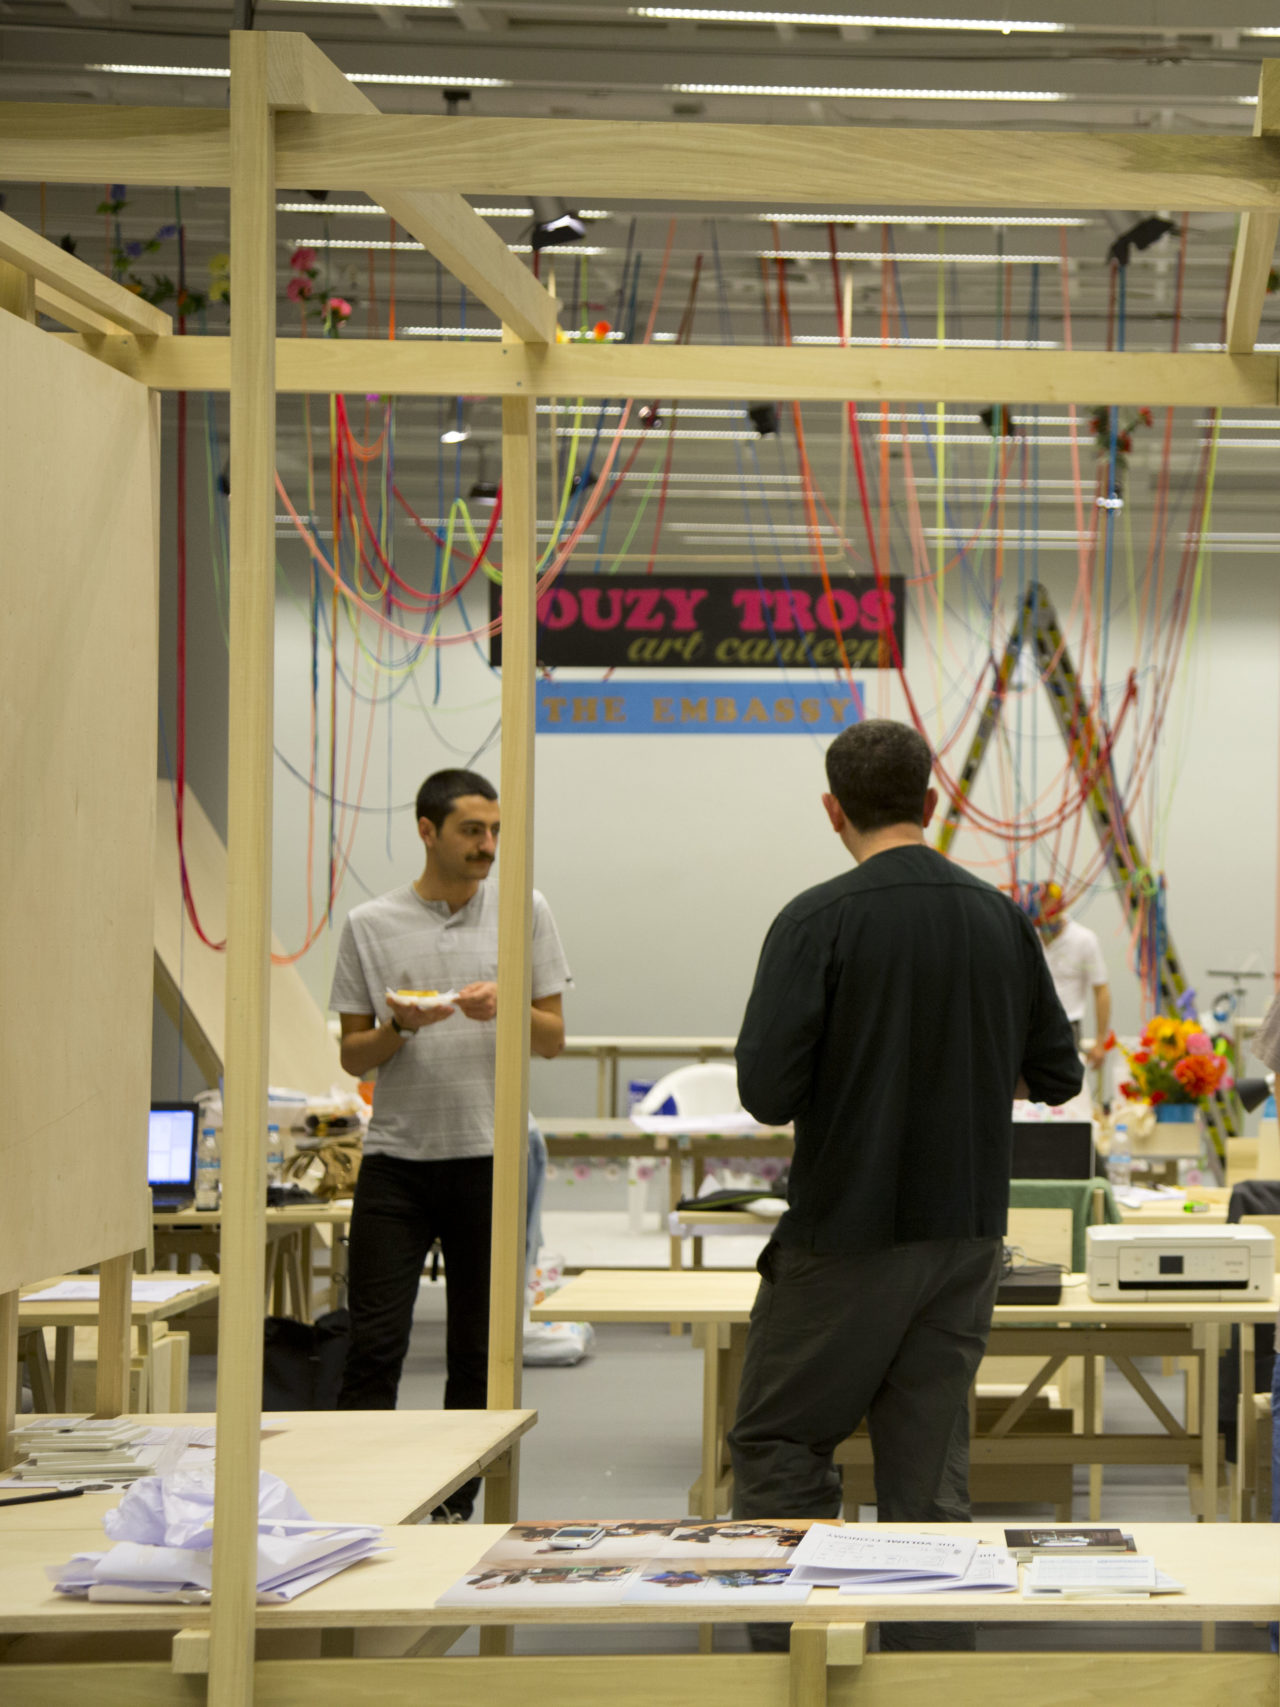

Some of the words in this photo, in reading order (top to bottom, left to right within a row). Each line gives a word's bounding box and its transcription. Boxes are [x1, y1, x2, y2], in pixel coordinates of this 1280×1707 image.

[499, 588, 708, 630] OUZY
[732, 589, 896, 631] TROS
[627, 630, 704, 662] art
[714, 631, 886, 664] canteen
[542, 697, 627, 723] THE
[652, 697, 851, 723] EMBASSY
